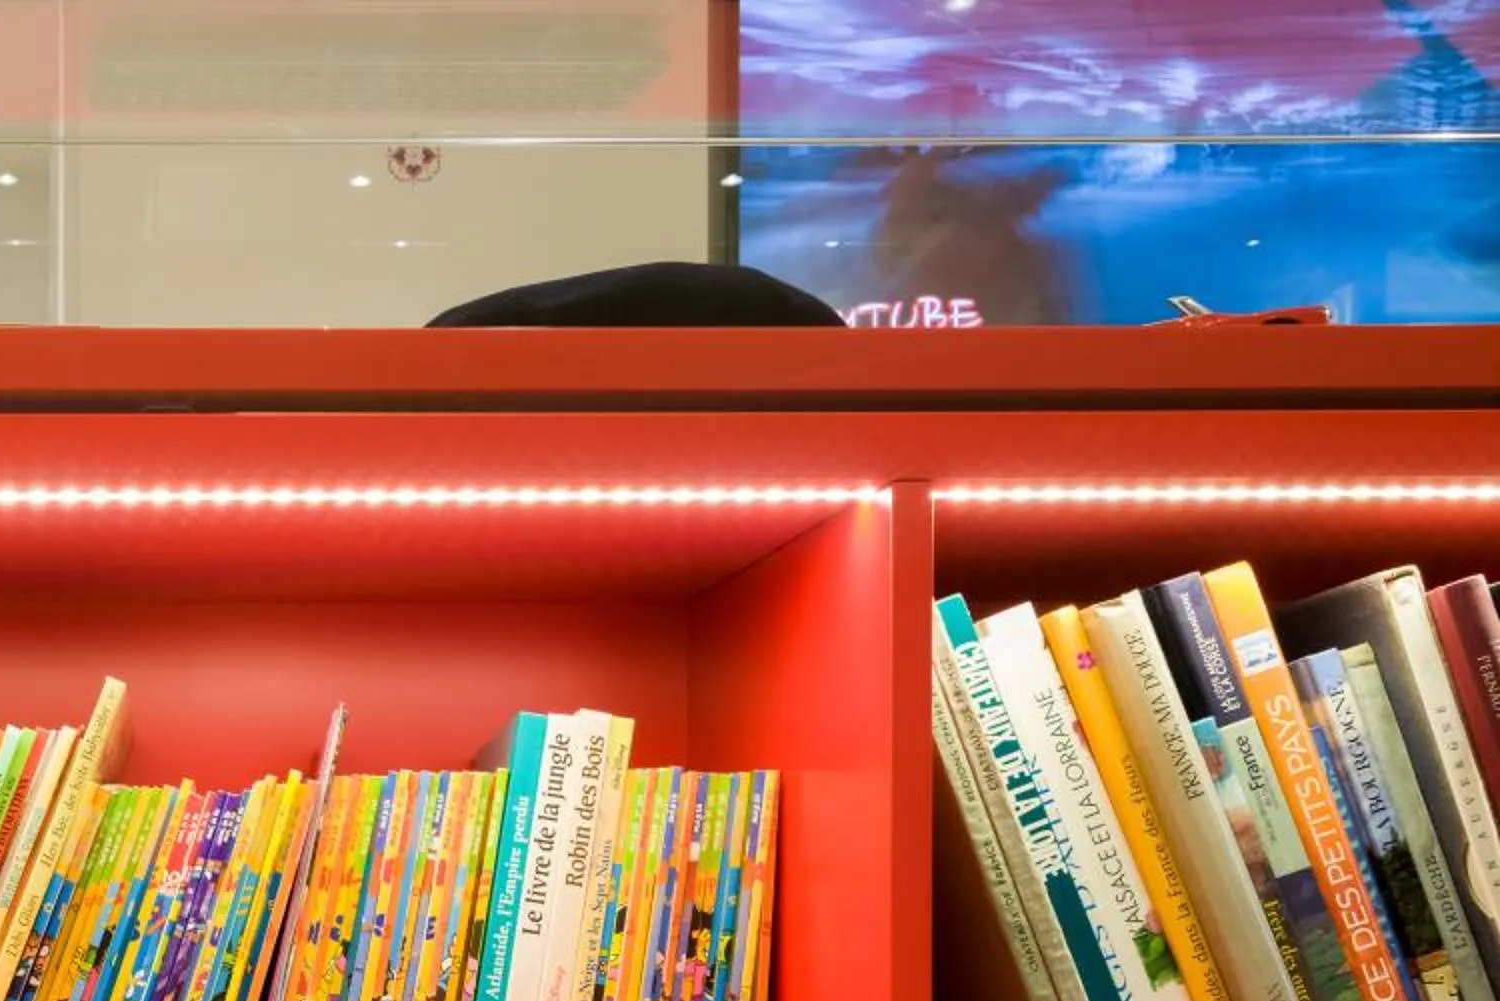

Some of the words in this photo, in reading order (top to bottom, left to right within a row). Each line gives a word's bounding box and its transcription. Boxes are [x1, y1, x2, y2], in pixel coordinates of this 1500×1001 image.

[1202, 633, 1228, 676] CORSE
[948, 639, 1021, 752] CHATEAUX
[1219, 676, 1235, 694] LA
[1147, 692, 1175, 725] MA
[1031, 683, 1089, 792] LORRAINE
[1263, 690, 1315, 776] PAYS
[1326, 681, 1387, 816] BOURGOGNE
[539, 731, 576, 801] jungle
[578, 733, 606, 781] Bois
[994, 748, 1032, 786] DE
[1234, 733, 1266, 792] France
[508, 795, 534, 843] perdu
[536, 800, 560, 822] la
[572, 782, 598, 822] des
[1007, 781, 1044, 818] LA
[1074, 790, 1101, 820] LA
[532, 825, 556, 852] de
[1085, 819, 1111, 846] ET
[1137, 809, 1160, 840] des
[1293, 775, 1355, 887] PETITS
[561, 824, 592, 889] Robin
[595, 837, 613, 878] Nains
[1019, 816, 1071, 881] LOIRE
[497, 846, 524, 917] l'Empire
[524, 854, 552, 905] livre
[1149, 841, 1184, 900] France
[521, 908, 544, 937] Le
[1172, 901, 1192, 921] la
[1334, 884, 1379, 953] DES
[1182, 924, 1209, 965] dans
[1279, 940, 1304, 971] des
